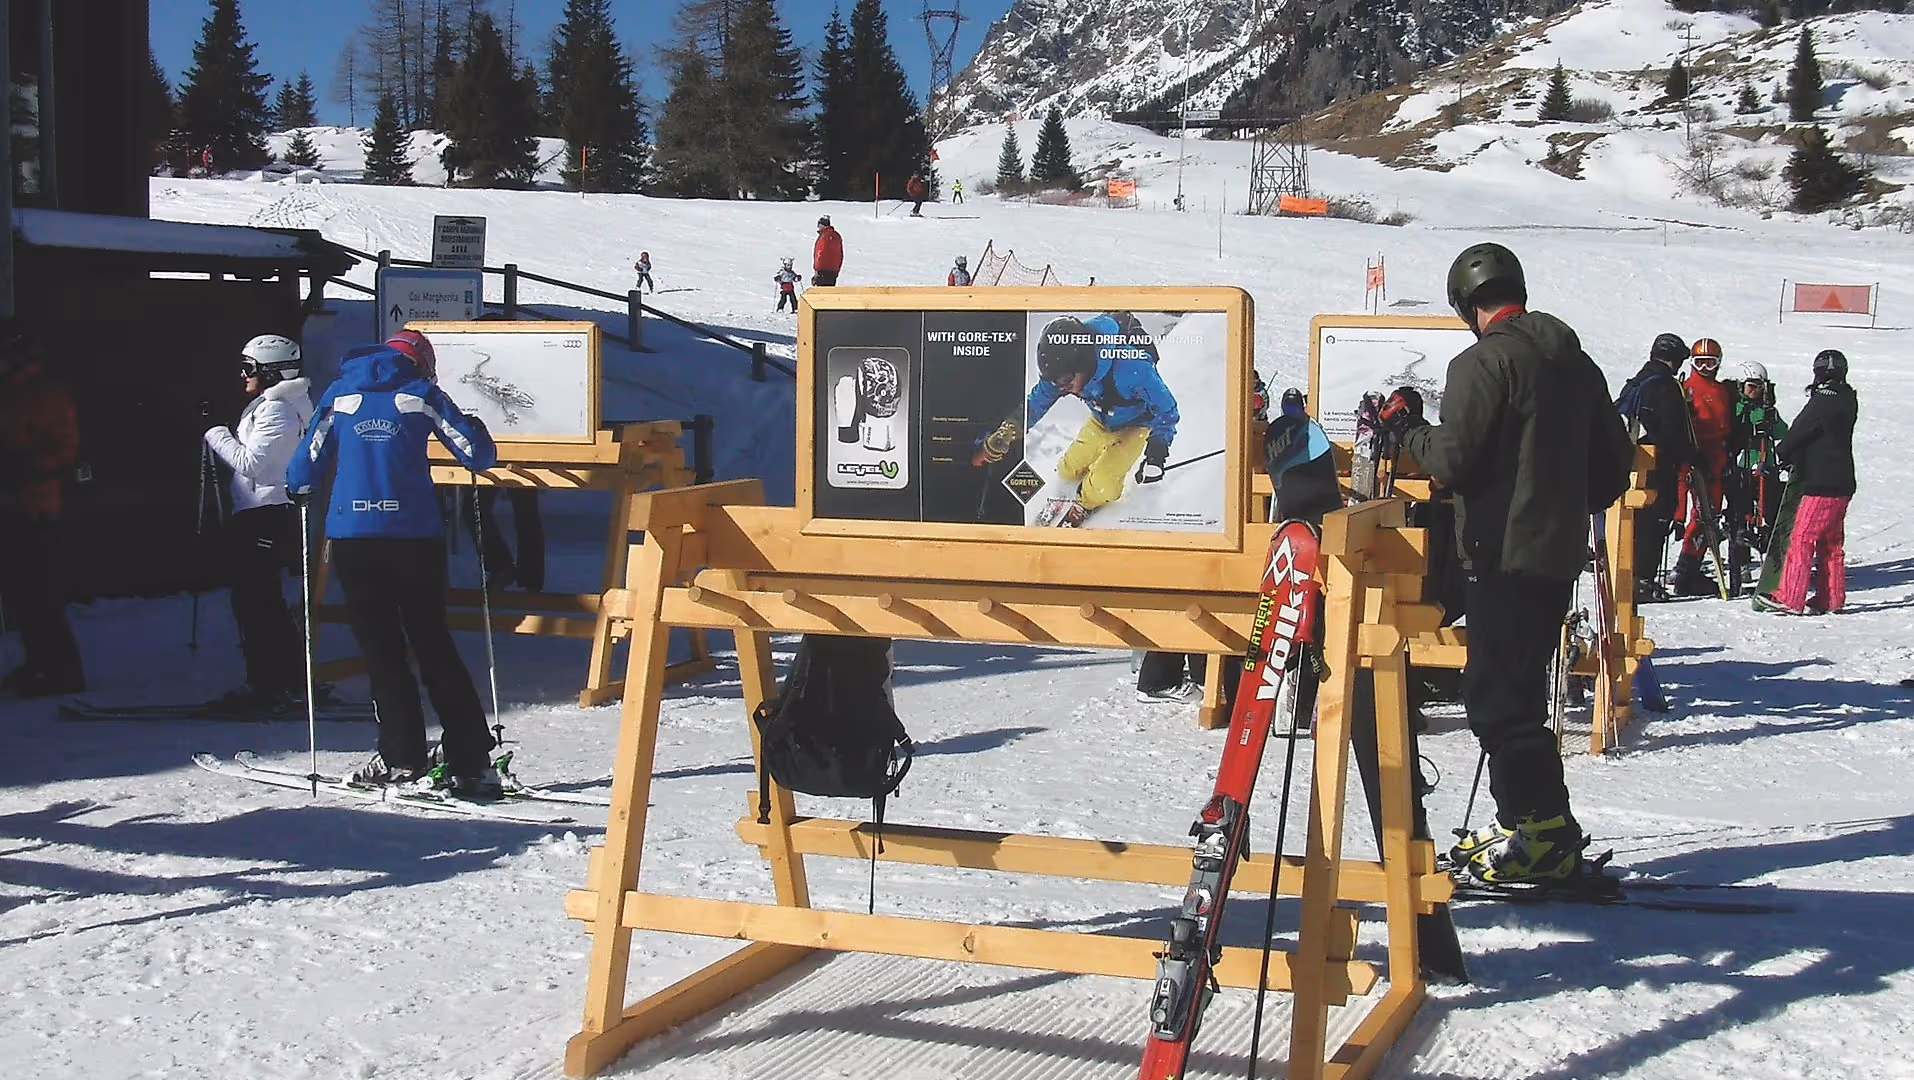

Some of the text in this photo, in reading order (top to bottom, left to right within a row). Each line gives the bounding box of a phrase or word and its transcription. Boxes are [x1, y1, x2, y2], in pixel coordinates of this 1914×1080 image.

[927, 332, 956, 342] WITH
[1047, 334, 1069, 345] YOU
[1071, 334, 1094, 345] FEEL
[1096, 334, 1126, 345] DRIER
[1130, 334, 1152, 345] AND
[953, 346, 990, 356] INSIDE
[352, 500, 400, 511] DKB
